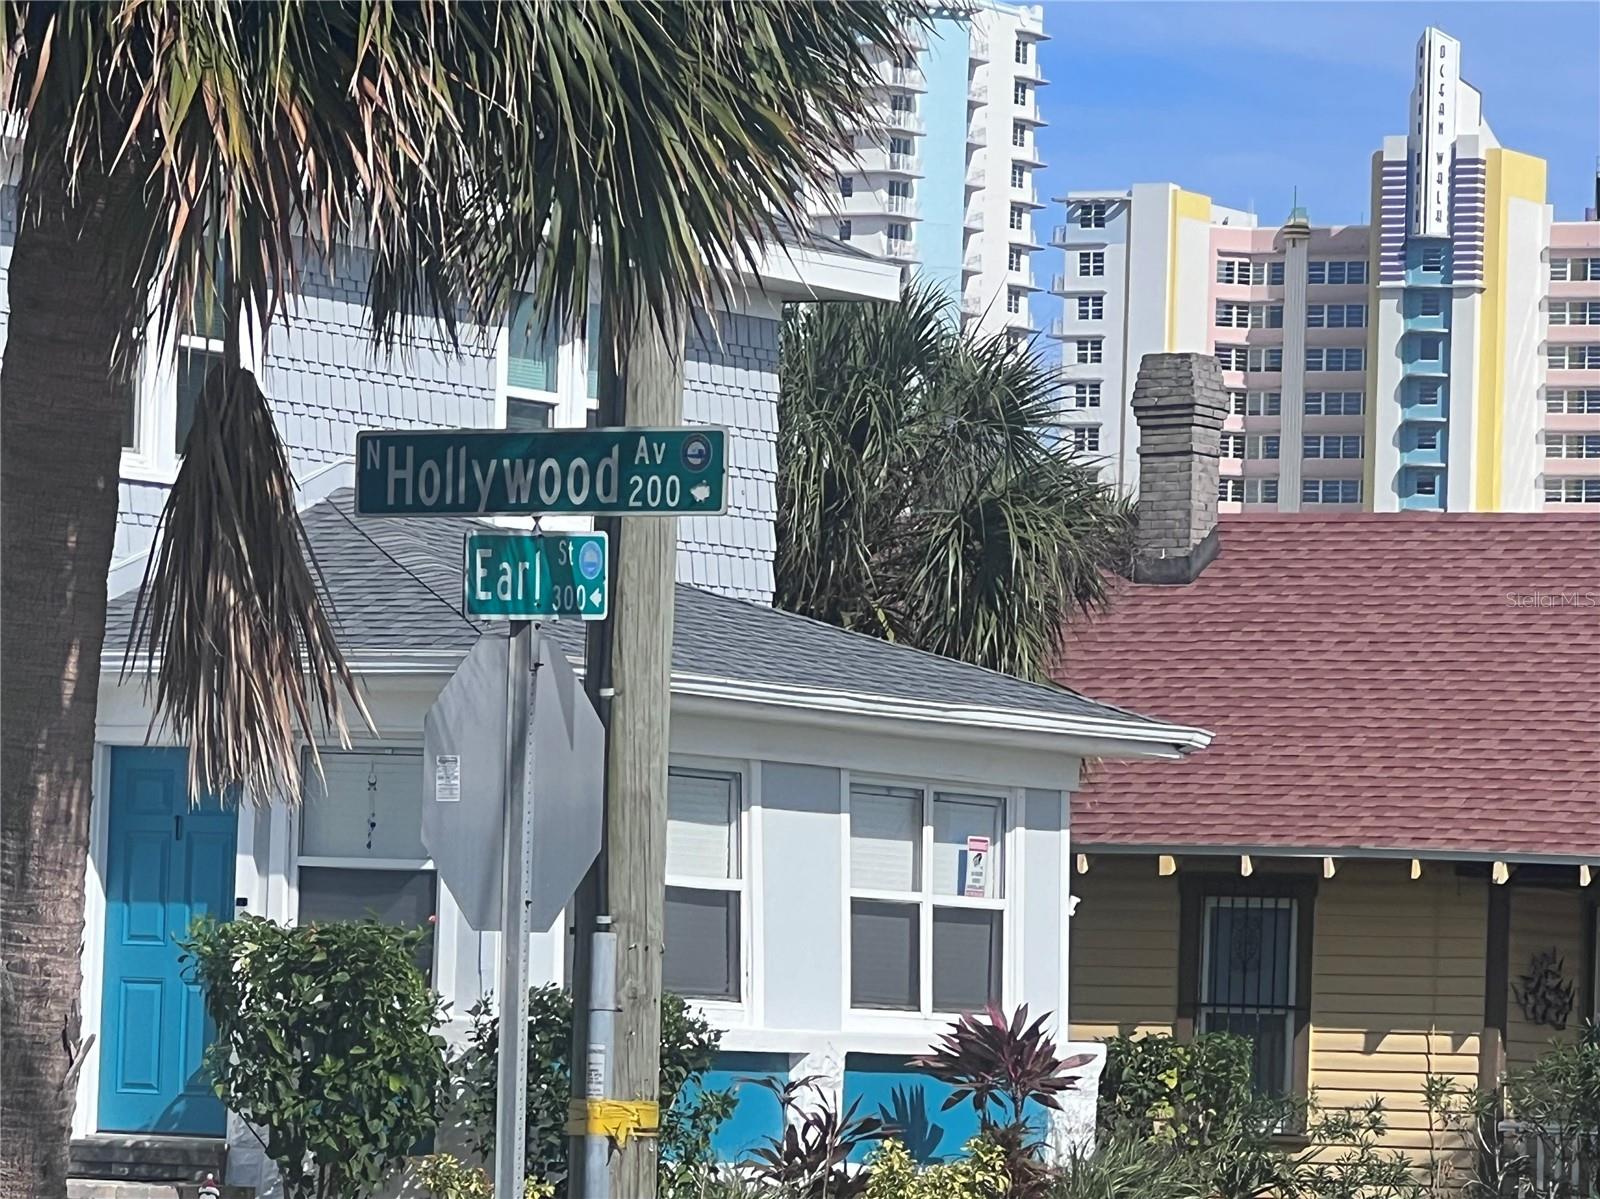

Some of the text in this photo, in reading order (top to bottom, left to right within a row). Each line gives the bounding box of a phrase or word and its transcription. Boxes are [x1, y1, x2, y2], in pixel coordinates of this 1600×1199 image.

[1438, 45, 1446, 135] OCEAN
[366, 435, 666, 512] N Hollywood Av
[628, 474, 681, 507] 200
[475, 539, 574, 601] Earl St
[552, 584, 587, 611] 300
